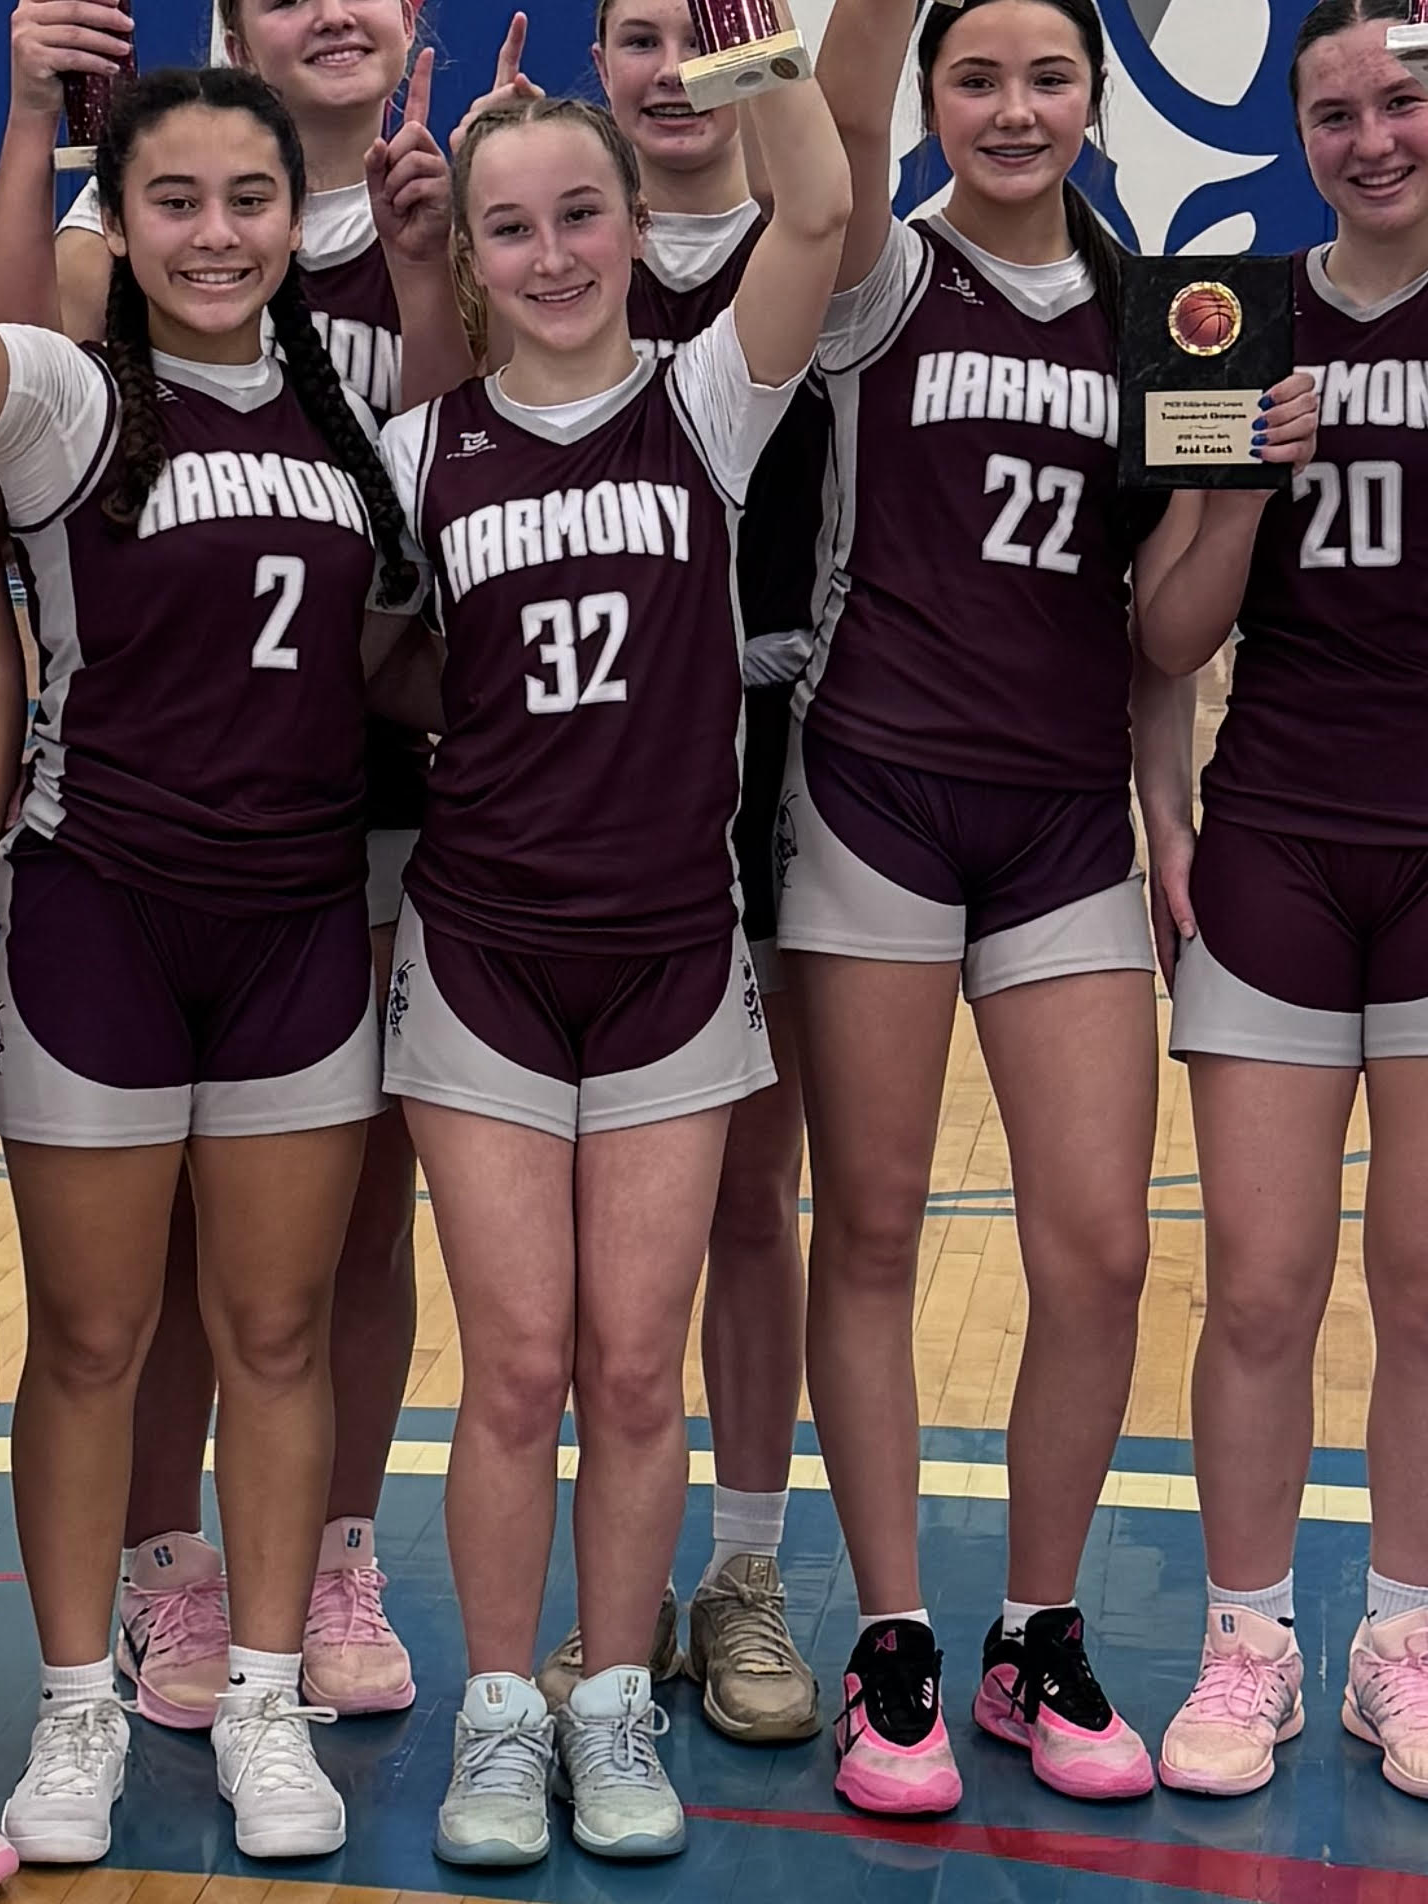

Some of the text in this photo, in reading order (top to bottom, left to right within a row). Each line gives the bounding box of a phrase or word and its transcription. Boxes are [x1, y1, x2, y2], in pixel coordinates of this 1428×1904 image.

[911, 351, 1119, 448] HARMO
[138, 451, 375, 549] HARMON
[440, 480, 689, 604] HARMONY
[982, 453, 1085, 574] 22
[1293, 460, 1402, 569] 20
[251, 554, 306, 671] 2
[521, 591, 629, 714] 32
